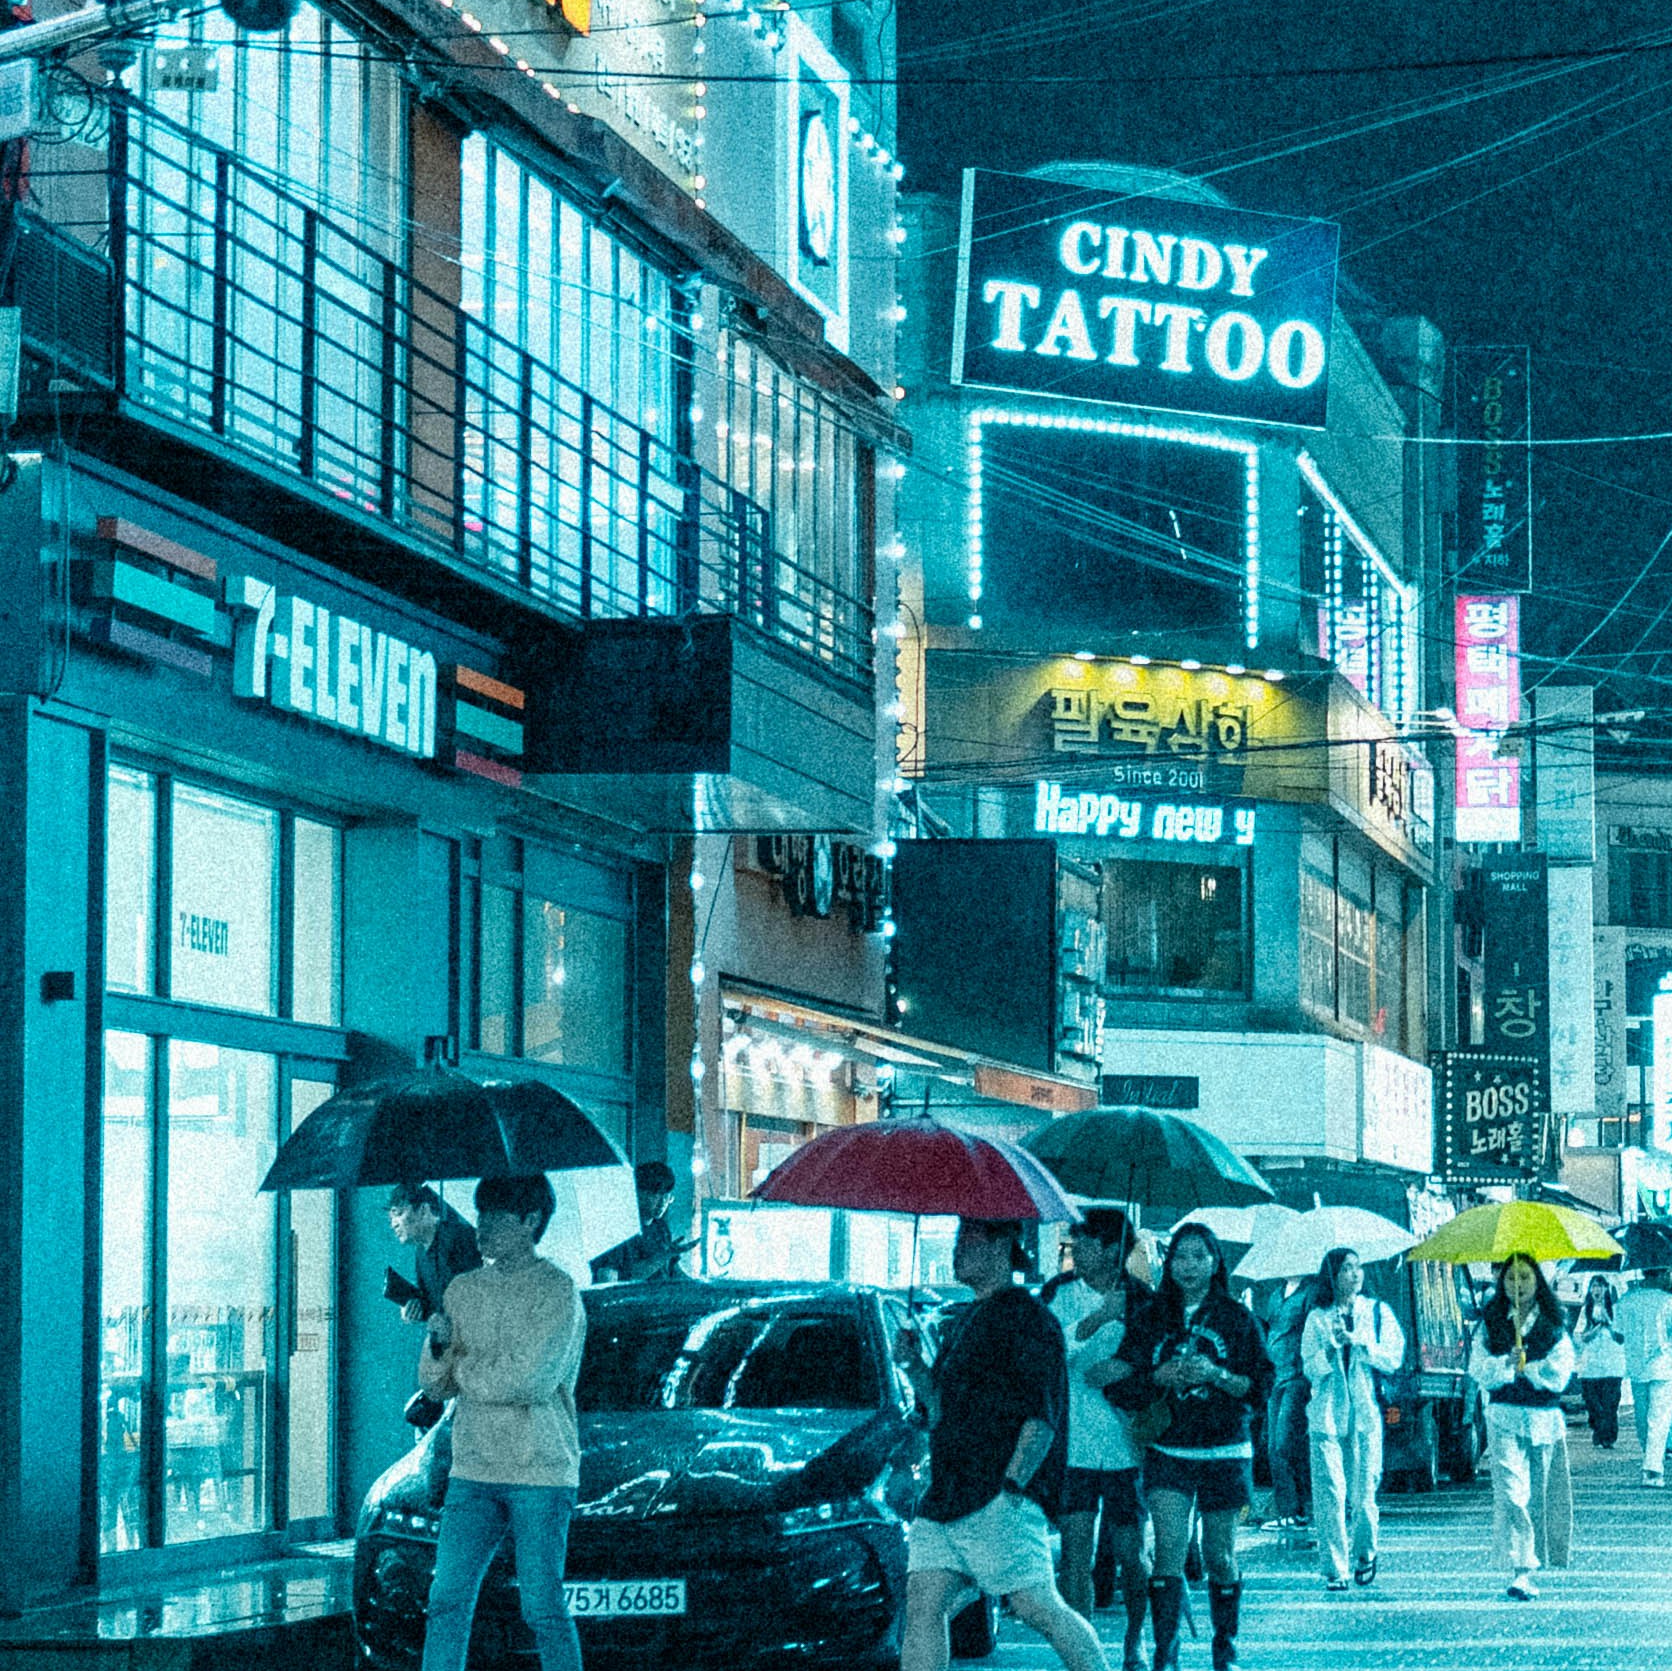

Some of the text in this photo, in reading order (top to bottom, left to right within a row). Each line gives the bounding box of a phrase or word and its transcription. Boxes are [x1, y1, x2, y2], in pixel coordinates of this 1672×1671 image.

[1061, 222, 1268, 297] CINDY
[984, 281, 1325, 389] TATTOO
[243, 576, 437, 758] 7-ELEVEN
[1114, 766, 1163, 788] Since
[1035, 780, 1141, 836] Happy
[1153, 806, 1222, 842] new
[179, 914, 230, 958] 7-ELEVEN
[1466, 1083, 1529, 1122] BOSS
[1470, 1122, 1523, 1154] 노래홀
